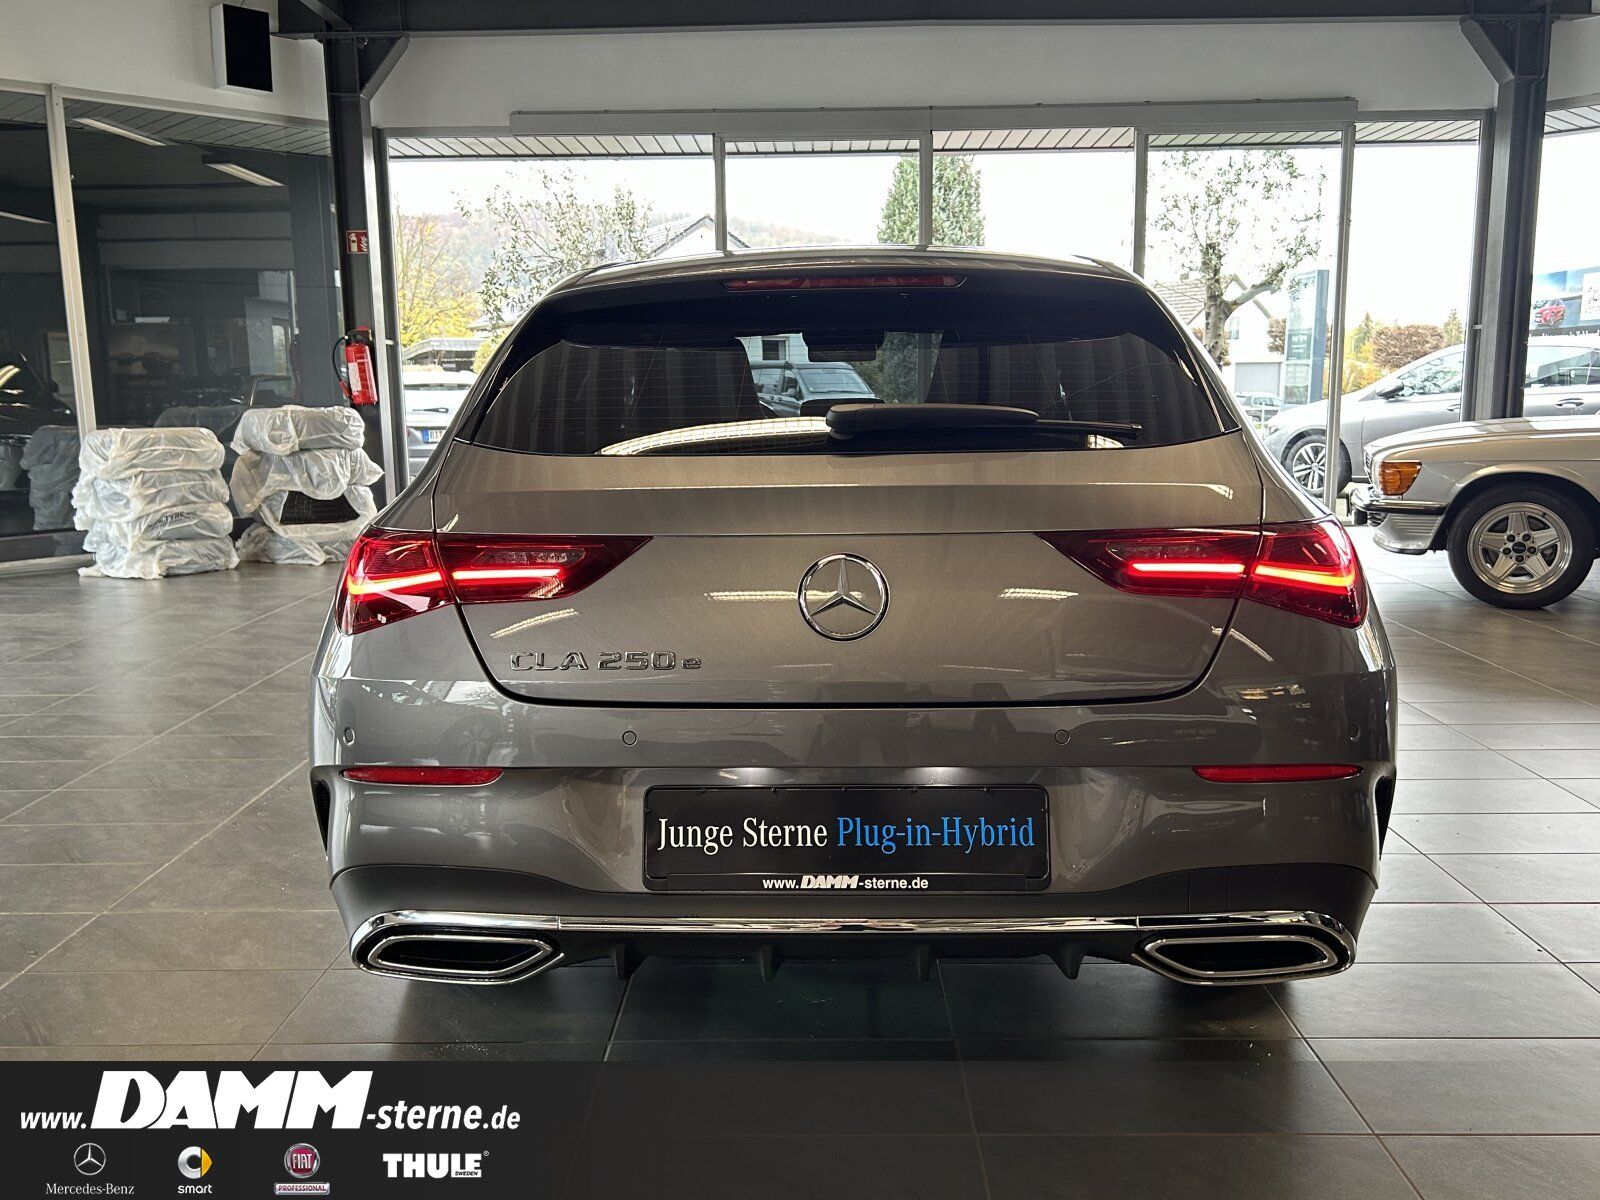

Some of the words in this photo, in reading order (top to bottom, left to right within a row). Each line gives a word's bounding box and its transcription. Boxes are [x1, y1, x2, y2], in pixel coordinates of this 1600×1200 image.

[510, 652, 589, 671] CLA
[657, 818, 733, 855] Junge
[743, 817, 828, 848] Sterne
[837, 817, 1035, 855] Plug-in-Hybrid
[762, 875, 929, 889] www.DAMM-sterne.de
